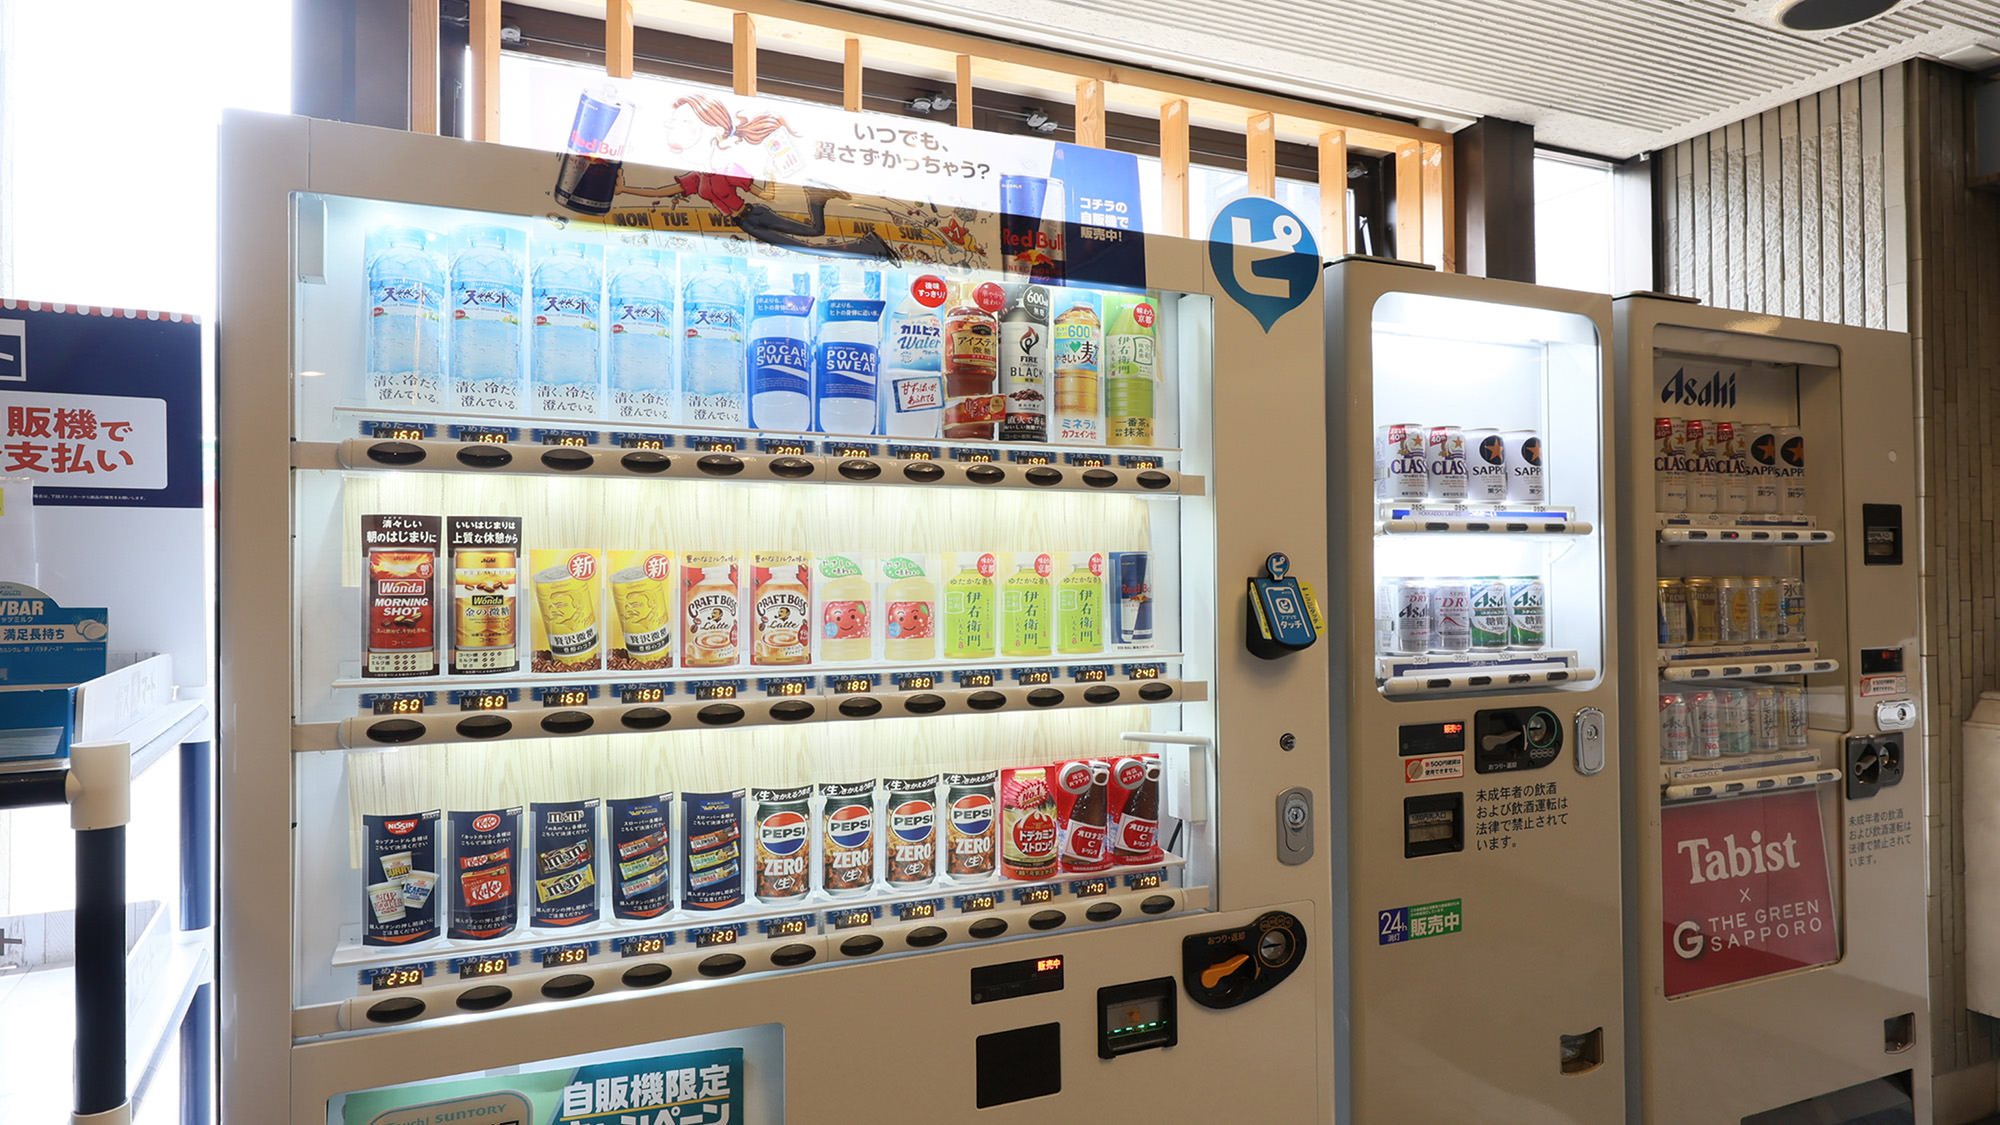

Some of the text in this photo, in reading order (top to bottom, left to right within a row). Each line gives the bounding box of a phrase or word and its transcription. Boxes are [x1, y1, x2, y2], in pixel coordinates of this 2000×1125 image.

[571, 130, 599, 152] Red
[854, 122, 948, 152] いつでも、
[1080, 197, 1128, 213] コチラの
[613, 212, 649, 226] MON
[661, 212, 689, 226] TUE
[1080, 211, 1129, 230] 自販機で
[1003, 228, 1064, 251] Red Bull
[1231, 215, 1302, 298] ピ
[462, 289, 514, 308] 天然水
[544, 296, 593, 314] 天然水
[901, 325, 940, 337] カルピス
[1068, 324, 1091, 338] 600
[897, 335, 942, 349] Water
[756, 355, 808, 368] SWEAT
[826, 360, 876, 372] SWEAT
[1010, 367, 1044, 377] BLACK
[1661, 366, 1736, 409] Asahi
[7, 406, 133, 442] 販機で
[393, 431, 420, 441] 160
[479, 435, 504, 443] 160
[560, 438, 584, 447] 160
[637, 441, 660, 450] 160
[710, 444, 732, 452] 160
[777, 447, 801, 455] 200
[844, 449, 867, 458] 200
[910, 452, 930, 461] 180
[455, 521, 516, 530] いいはじまりは
[366, 531, 437, 543] 朝のはじまりに
[452, 533, 518, 544] 上質な休憩から
[571, 557, 594, 577] 新
[648, 557, 667, 577] 新
[1272, 556, 1286, 572] ピ
[381, 582, 423, 593] Wonda
[1121, 583, 1140, 593] Red
[375, 598, 429, 607] MORNING
[474, 596, 503, 605] Wonda
[688, 595, 737, 618] CRAFT BOSS
[757, 594, 808, 617] CRAFT BOSS
[384, 607, 419, 616] SHOT
[465, 607, 511, 617] 金の微糖
[1024, 590, 1038, 645] 伊右衛門
[1079, 589, 1093, 643] 伊右衛門
[768, 620, 799, 629] Latte
[967, 590, 981, 647] 伊右衛門
[1280, 620, 1302, 629] タッチ
[701, 622, 730, 630] Latte
[4, 628, 65, 640] 満足長持ち
[972, 674, 990, 685] 170
[1029, 672, 1048, 682] 170
[1085, 670, 1103, 680] 170
[1136, 668, 1155, 679] 240
[782, 683, 802, 694] 190
[847, 680, 867, 691] 180
[911, 677, 930, 688] 180
[560, 692, 584, 704] 160
[638, 689, 661, 700] 160
[711, 686, 734, 697] 190
[392, 698, 419, 711] 160
[478, 695, 504, 708] 160
[1443, 724, 1462, 734] 販売中
[1022, 787, 1041, 801] No.1
[1476, 782, 1557, 802] 未成年者の飲酒
[953, 808, 992, 820] PEPSI
[1476, 797, 1569, 819] および飲酒運転は
[894, 814, 933, 826] PEPSI
[1849, 808, 1904, 826] 未成年者の飲酒
[387, 822, 415, 830] NISSIN
[830, 820, 871, 832] PEPSI
[1476, 813, 1569, 835] 法律で禁止されて
[1849, 821, 1911, 840] および飲酒運転は
[762, 826, 806, 839] PEPSI
[1019, 828, 1055, 841] ドデカミン
[956, 837, 991, 854] ZERO
[1476, 836, 1517, 851] います。
[1849, 834, 1911, 854] 法律で禁止されて
[832, 850, 869, 868] ZERO
[895, 844, 931, 862] ZERO
[1677, 830, 1800, 885] Tabist
[763, 858, 804, 876] ZERO
[1086, 883, 1104, 893] 170
[1140, 876, 1157, 887] 170
[1031, 890, 1049, 901] 170
[973, 897, 991, 908] 170
[912, 905, 931, 916] 170
[1708, 899, 1820, 933] THE GREEN
[848, 913, 869, 925] 170
[1411, 912, 1460, 937] 販売中
[780, 921, 803, 933] 170
[710, 930, 733, 943] 120
[1673, 920, 1704, 959] G
[1711, 917, 1822, 952] SAPPORO
[636, 939, 661, 952] 120
[559, 949, 584, 963] 150
[477, 959, 504, 973] 160
[1037, 958, 1061, 972] 販売中
[387, 971, 419, 986] 230
[562, 1064, 730, 1115] 自販機限定
[435, 1103, 507, 1124] SUNTORY
